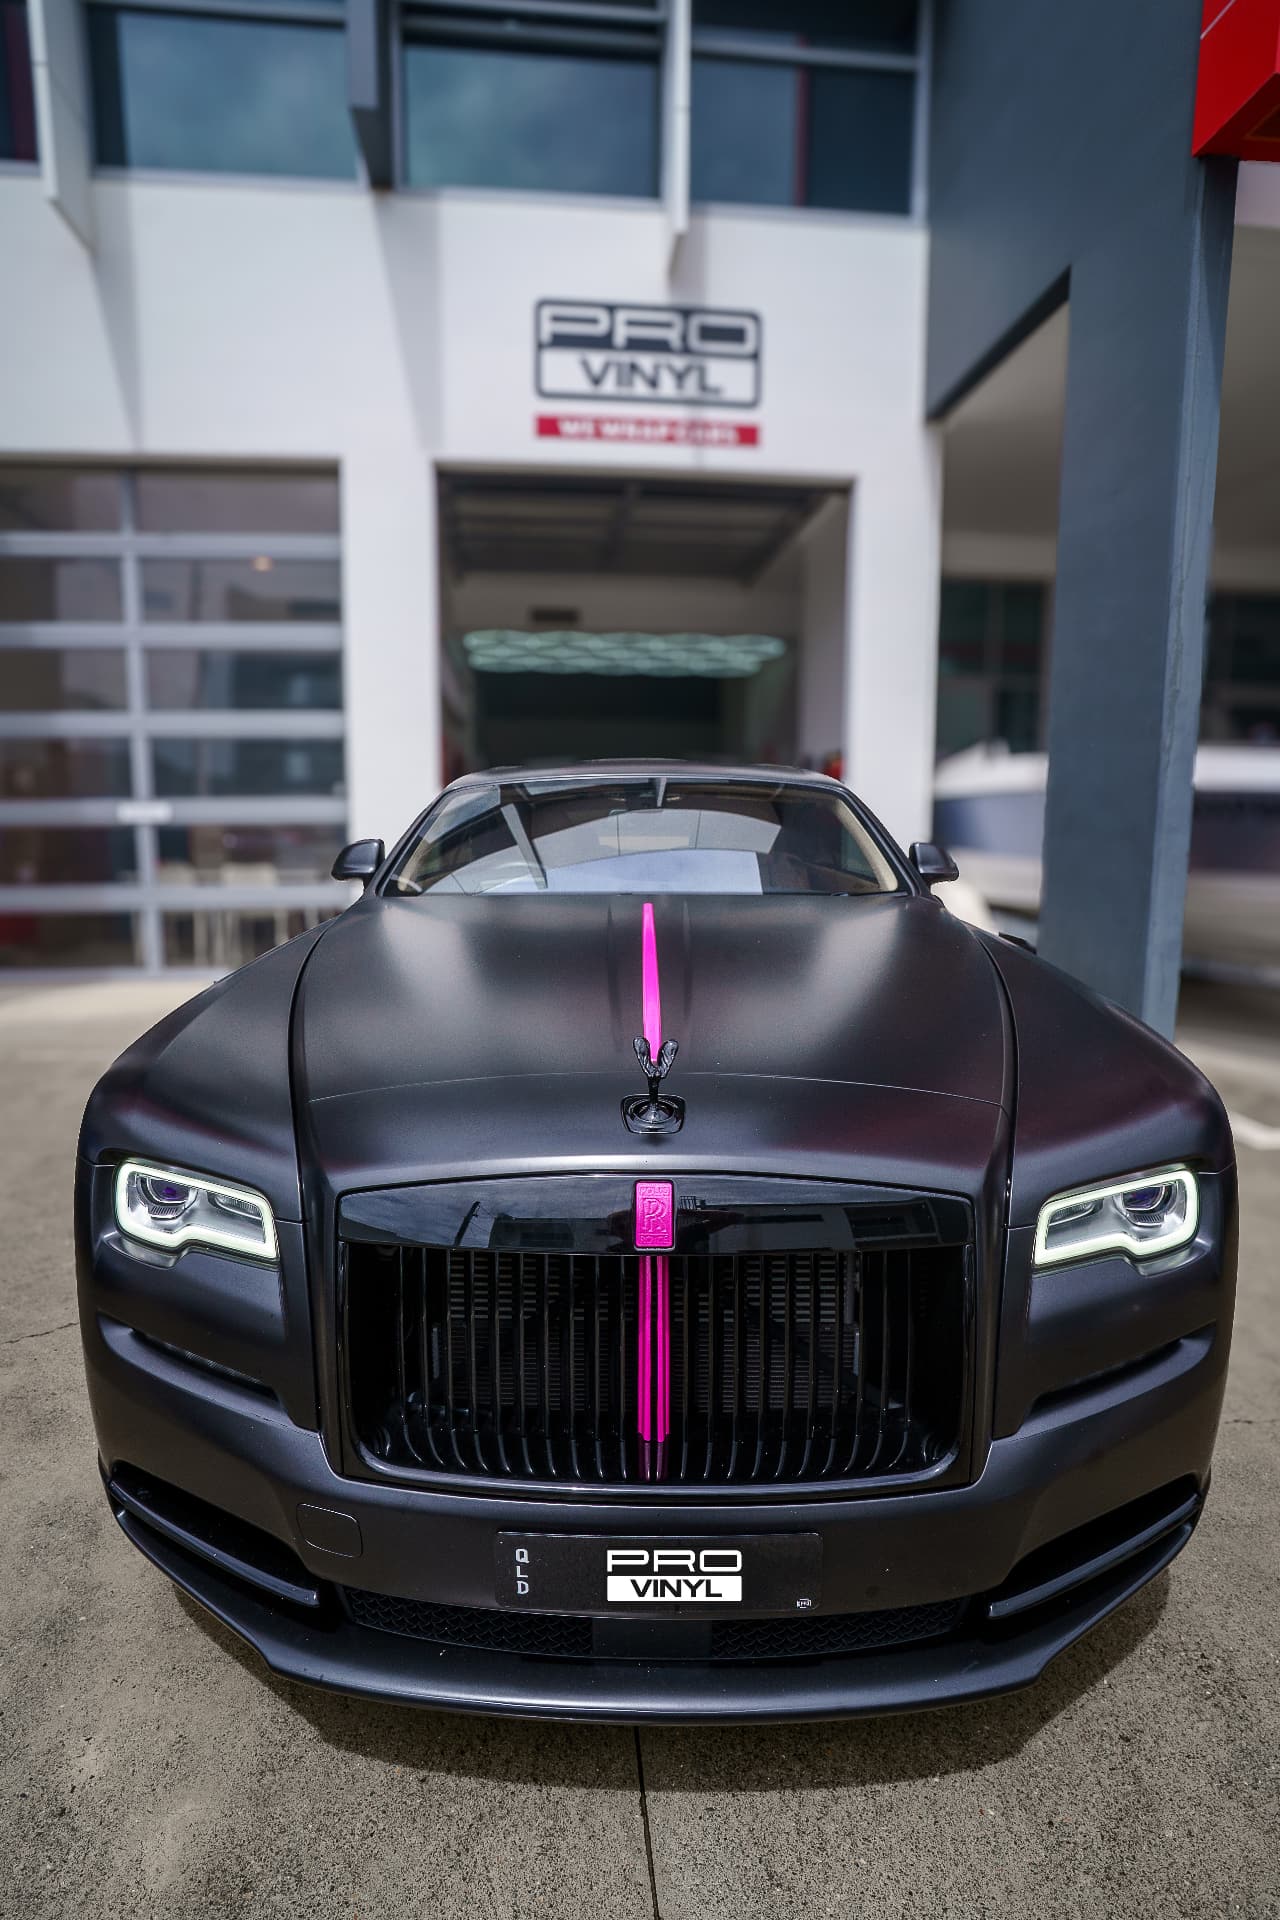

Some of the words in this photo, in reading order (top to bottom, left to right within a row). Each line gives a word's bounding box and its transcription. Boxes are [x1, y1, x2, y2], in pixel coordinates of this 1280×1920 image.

[538, 303, 758, 353] PRO
[580, 356, 723, 395] VINYL
[515, 1548, 530, 1595] QLD
[606, 1549, 743, 1573] PRO
[630, 1578, 723, 1598] VINYL
